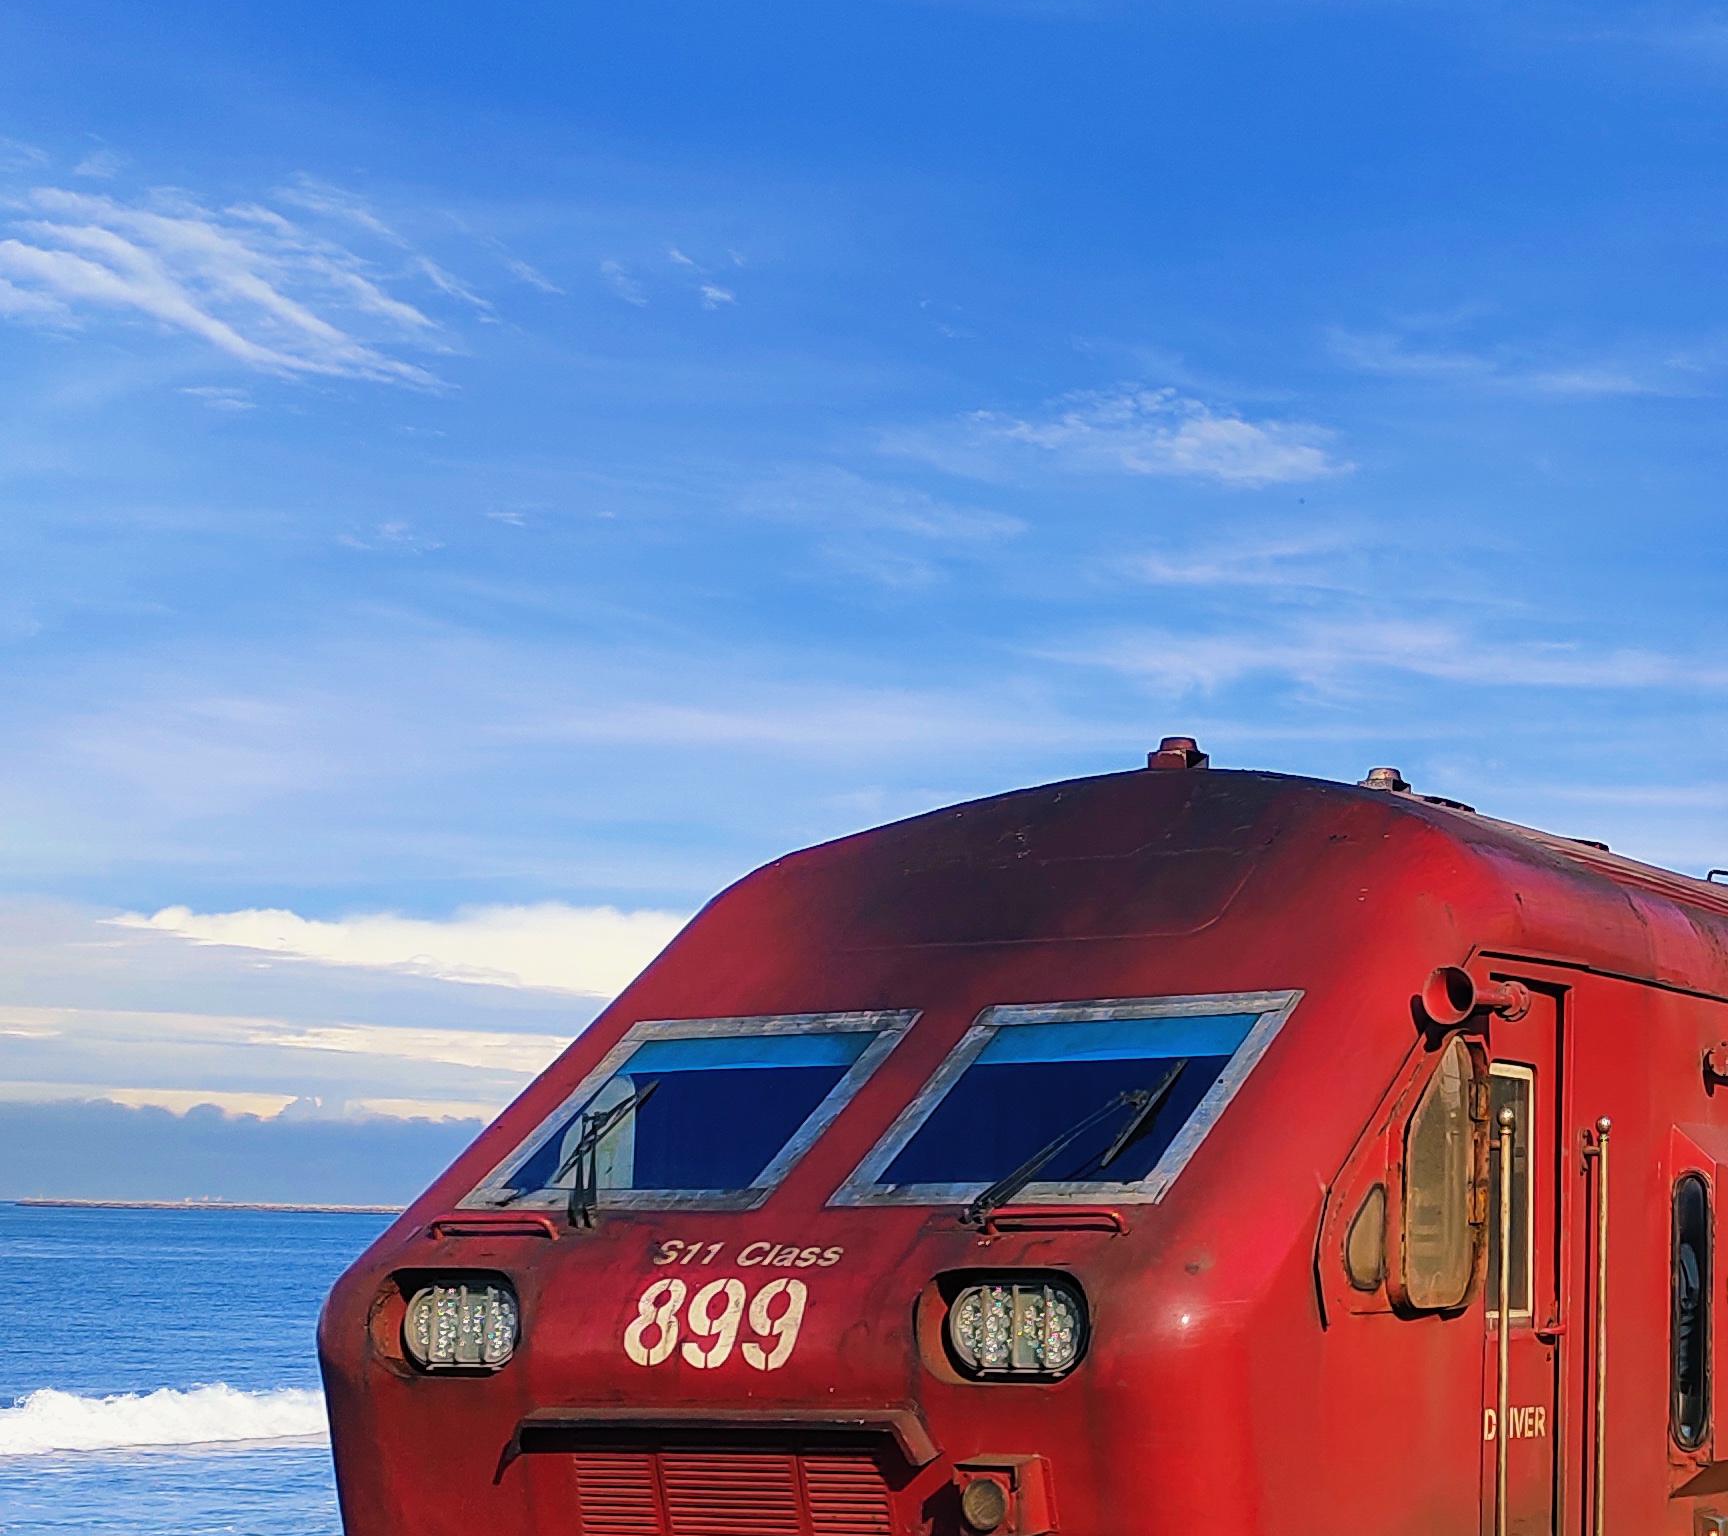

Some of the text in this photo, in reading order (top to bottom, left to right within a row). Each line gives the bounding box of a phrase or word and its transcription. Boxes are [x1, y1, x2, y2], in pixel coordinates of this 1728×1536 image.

[653, 1239, 845, 1267] S11 Class
[623, 1278, 808, 1372] 899
[1483, 1406, 1546, 1441] DIVER
